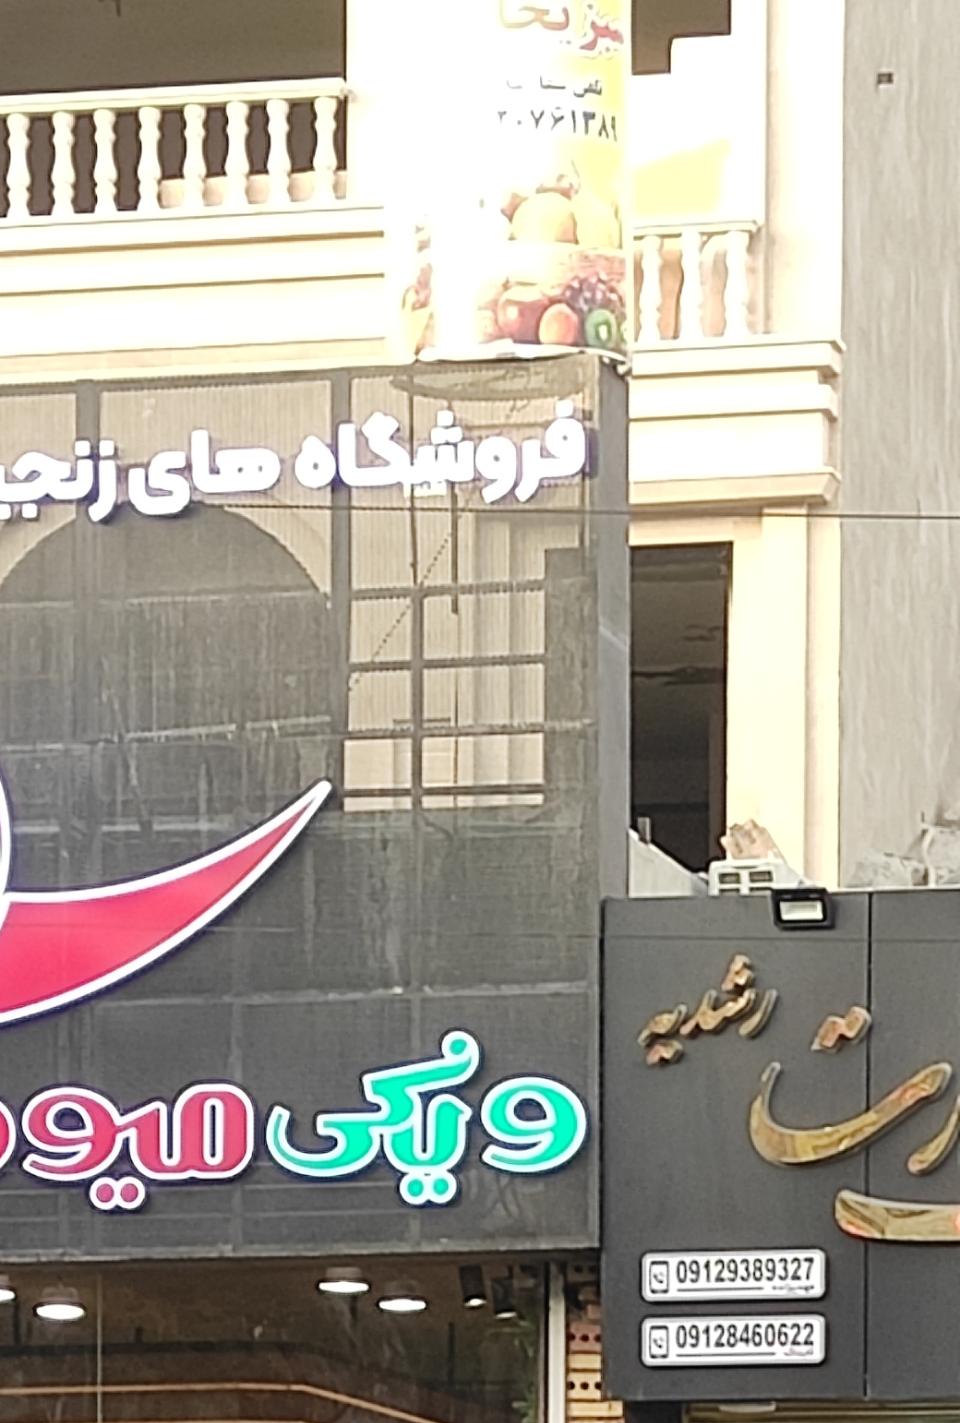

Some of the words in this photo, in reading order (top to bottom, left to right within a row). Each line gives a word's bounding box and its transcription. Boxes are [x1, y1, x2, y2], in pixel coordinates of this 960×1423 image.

[128, 428, 282, 517] های
[294, 399, 589, 503] فروشگاه
[265, 1029, 588, 1206] ویکی
[676, 1256, 815, 1284] 09129389327
[676, 1322, 815, 1350] 09128460622
